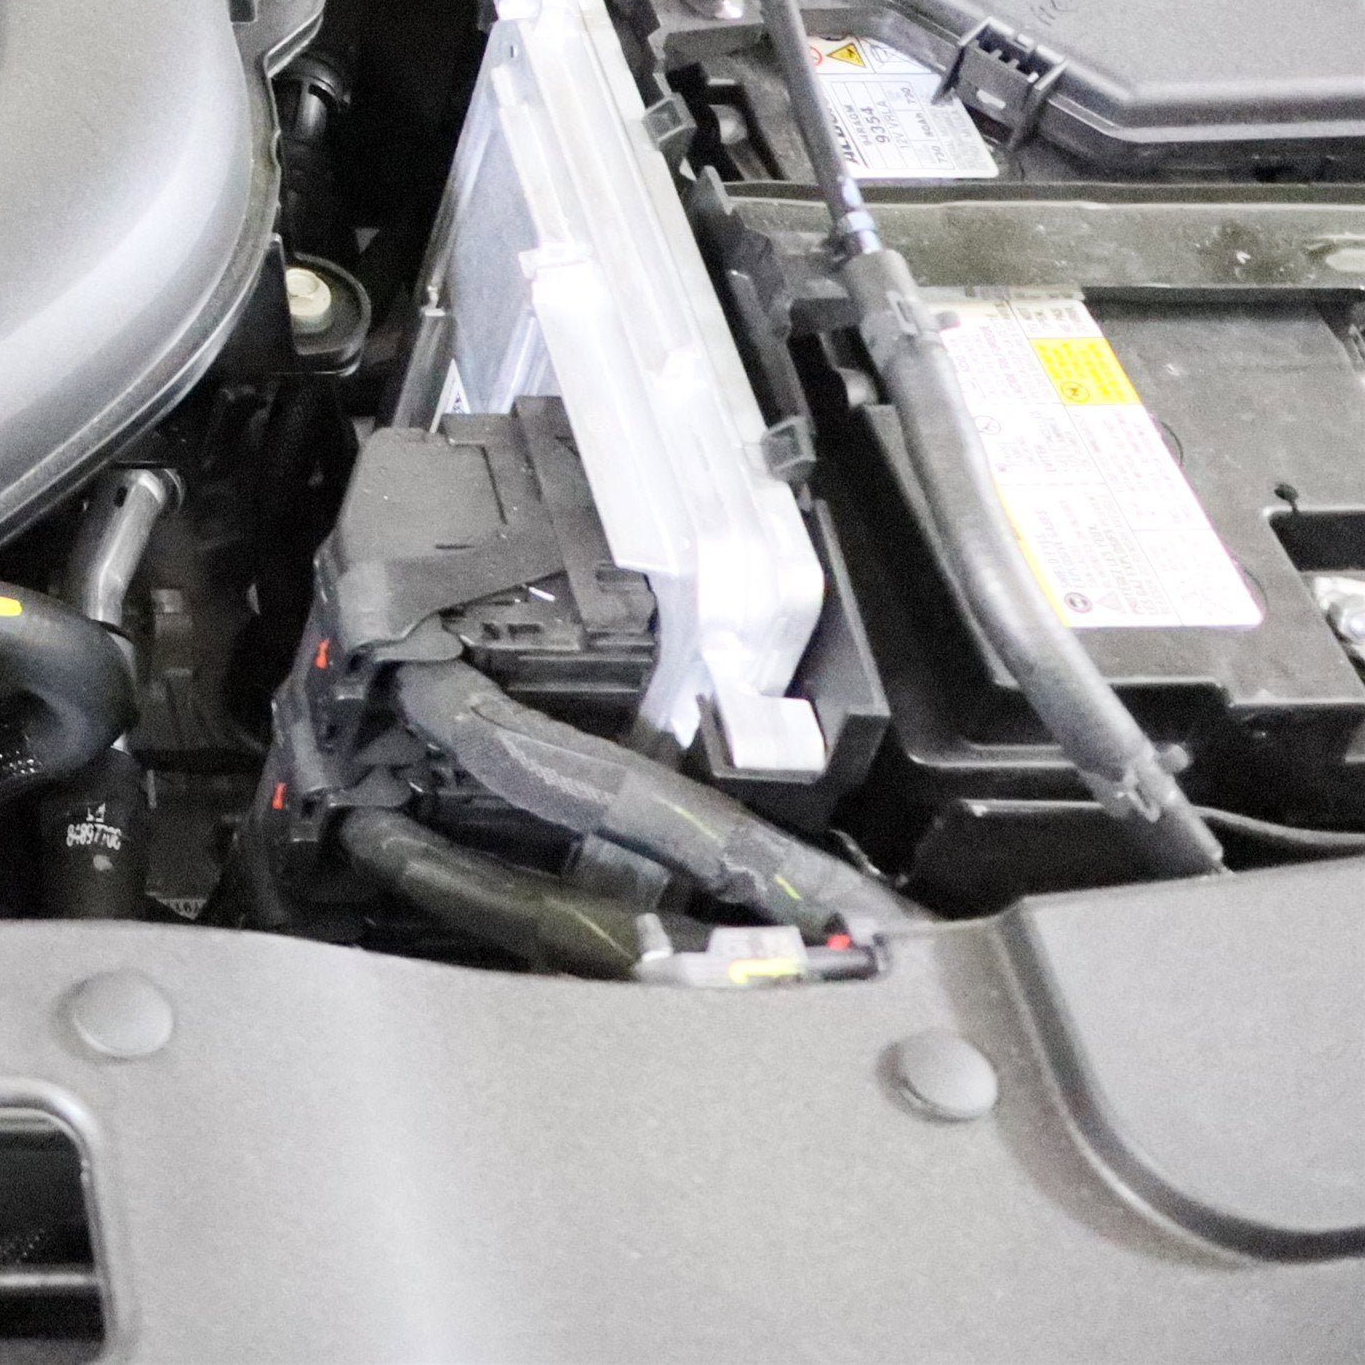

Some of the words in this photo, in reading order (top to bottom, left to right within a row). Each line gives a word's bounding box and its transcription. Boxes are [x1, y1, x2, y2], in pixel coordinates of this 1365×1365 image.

[861, 106, 890, 143] 9354
[879, 100, 900, 129] VRLA
[893, 132, 911, 149] 12V
